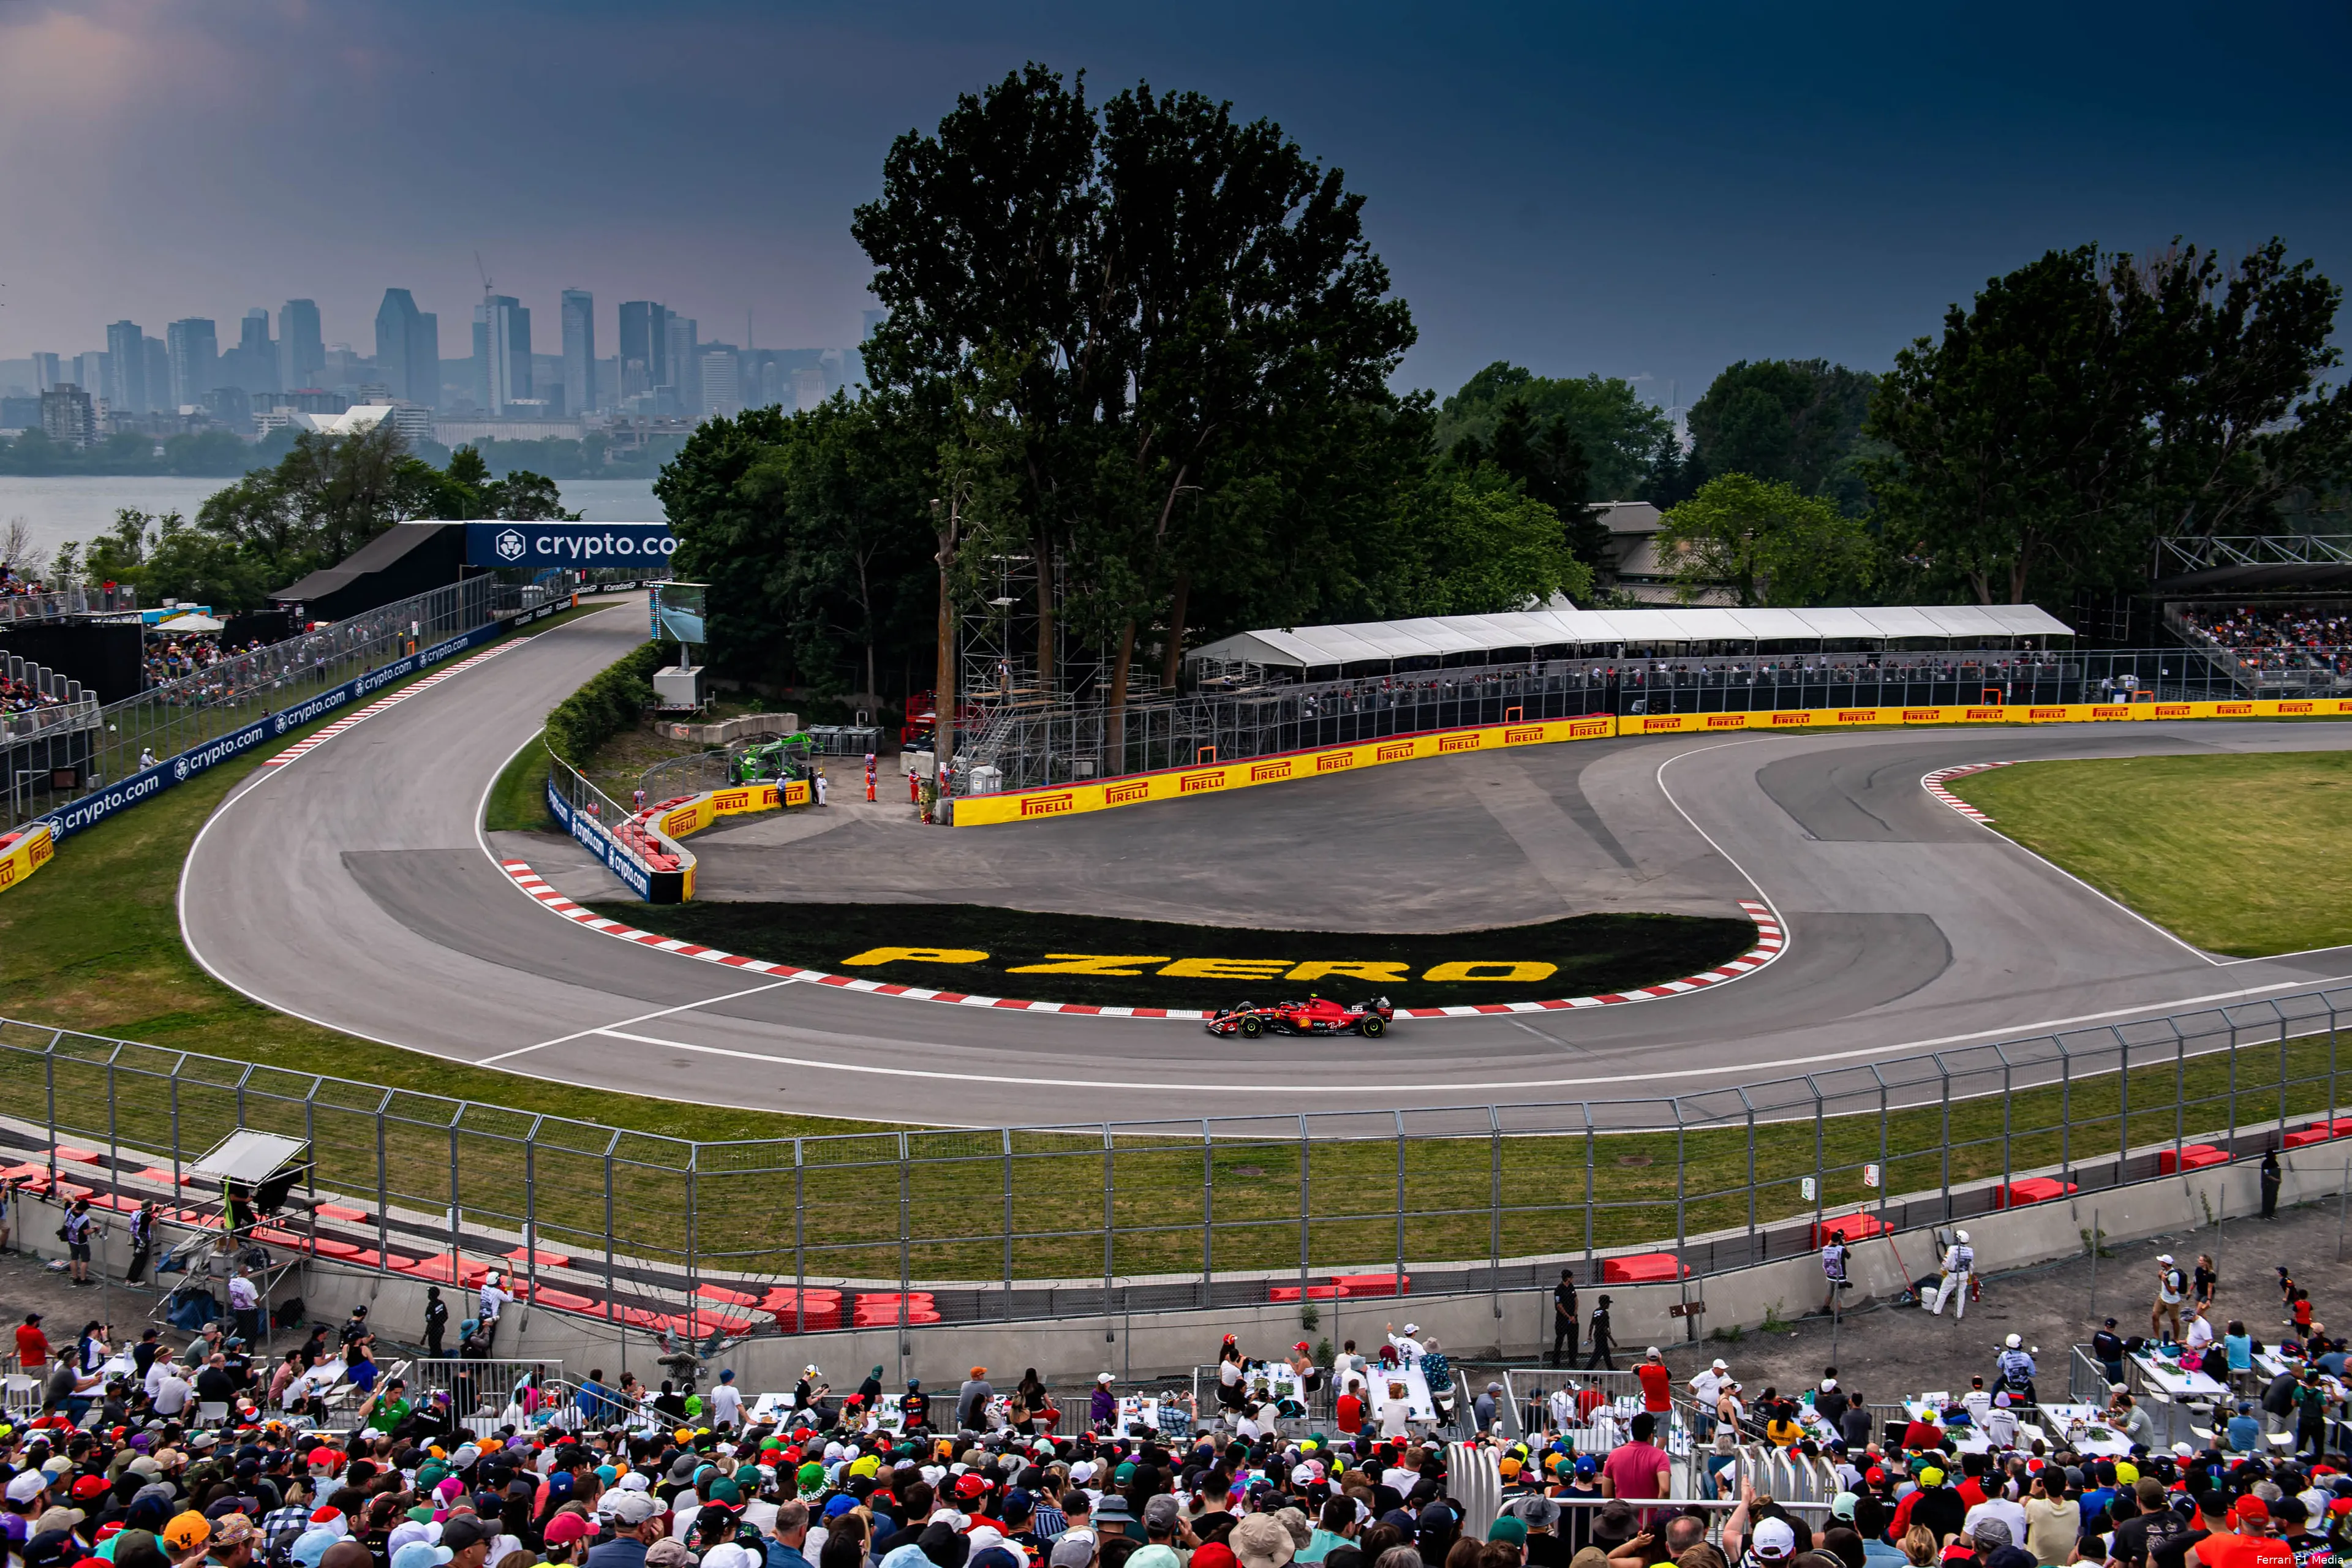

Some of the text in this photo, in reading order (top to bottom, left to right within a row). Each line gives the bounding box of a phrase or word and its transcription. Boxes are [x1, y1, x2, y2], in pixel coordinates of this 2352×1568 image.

[536, 533, 682, 559] crypto.co
[428, 636, 468, 662] crypto.com
[365, 660, 412, 690] crypto.com
[288, 690, 345, 725] crypto.com
[1838, 711, 1876, 722] PIRELLI
[1902, 710, 1940, 721] PIRELLI
[1966, 709, 2003, 719] PIRELLI
[2029, 708, 2067, 718] PIRELLI
[2092, 707, 2129, 717] PIRELLI
[2155, 705, 2191, 715] PIRELLI
[2217, 704, 2252, 714] PIRELLI
[2278, 703, 2313, 713] PIRELLI
[1569, 720, 1608, 737] PIRELLI
[1643, 718, 1681, 729] PIRELLI
[1707, 715, 1745, 727] PIRELLI
[1772, 713, 1811, 725] PIRELLI
[1439, 733, 1480, 752] PIRELLI
[1504, 726, 1544, 744] PIRELLI
[190, 727, 263, 770] crypto.com
[1377, 742, 1414, 761] PIRELLI
[1316, 752, 1353, 771] PIRELLI
[1251, 761, 1291, 782] PIRELLI
[1180, 771, 1225, 793] PIRELLI
[66, 775, 159, 829] crypto.com
[1106, 782, 1148, 804] PIRELLI
[1021, 793, 1073, 816] PIRELLI
[669, 809, 697, 837] PIRELLI
[576, 821, 605, 856] crypto.com
[614, 856, 647, 895] crypto.com
[840, 946, 1558, 982] P ZERO
[417, 1412, 440, 1422] ETRONAS
